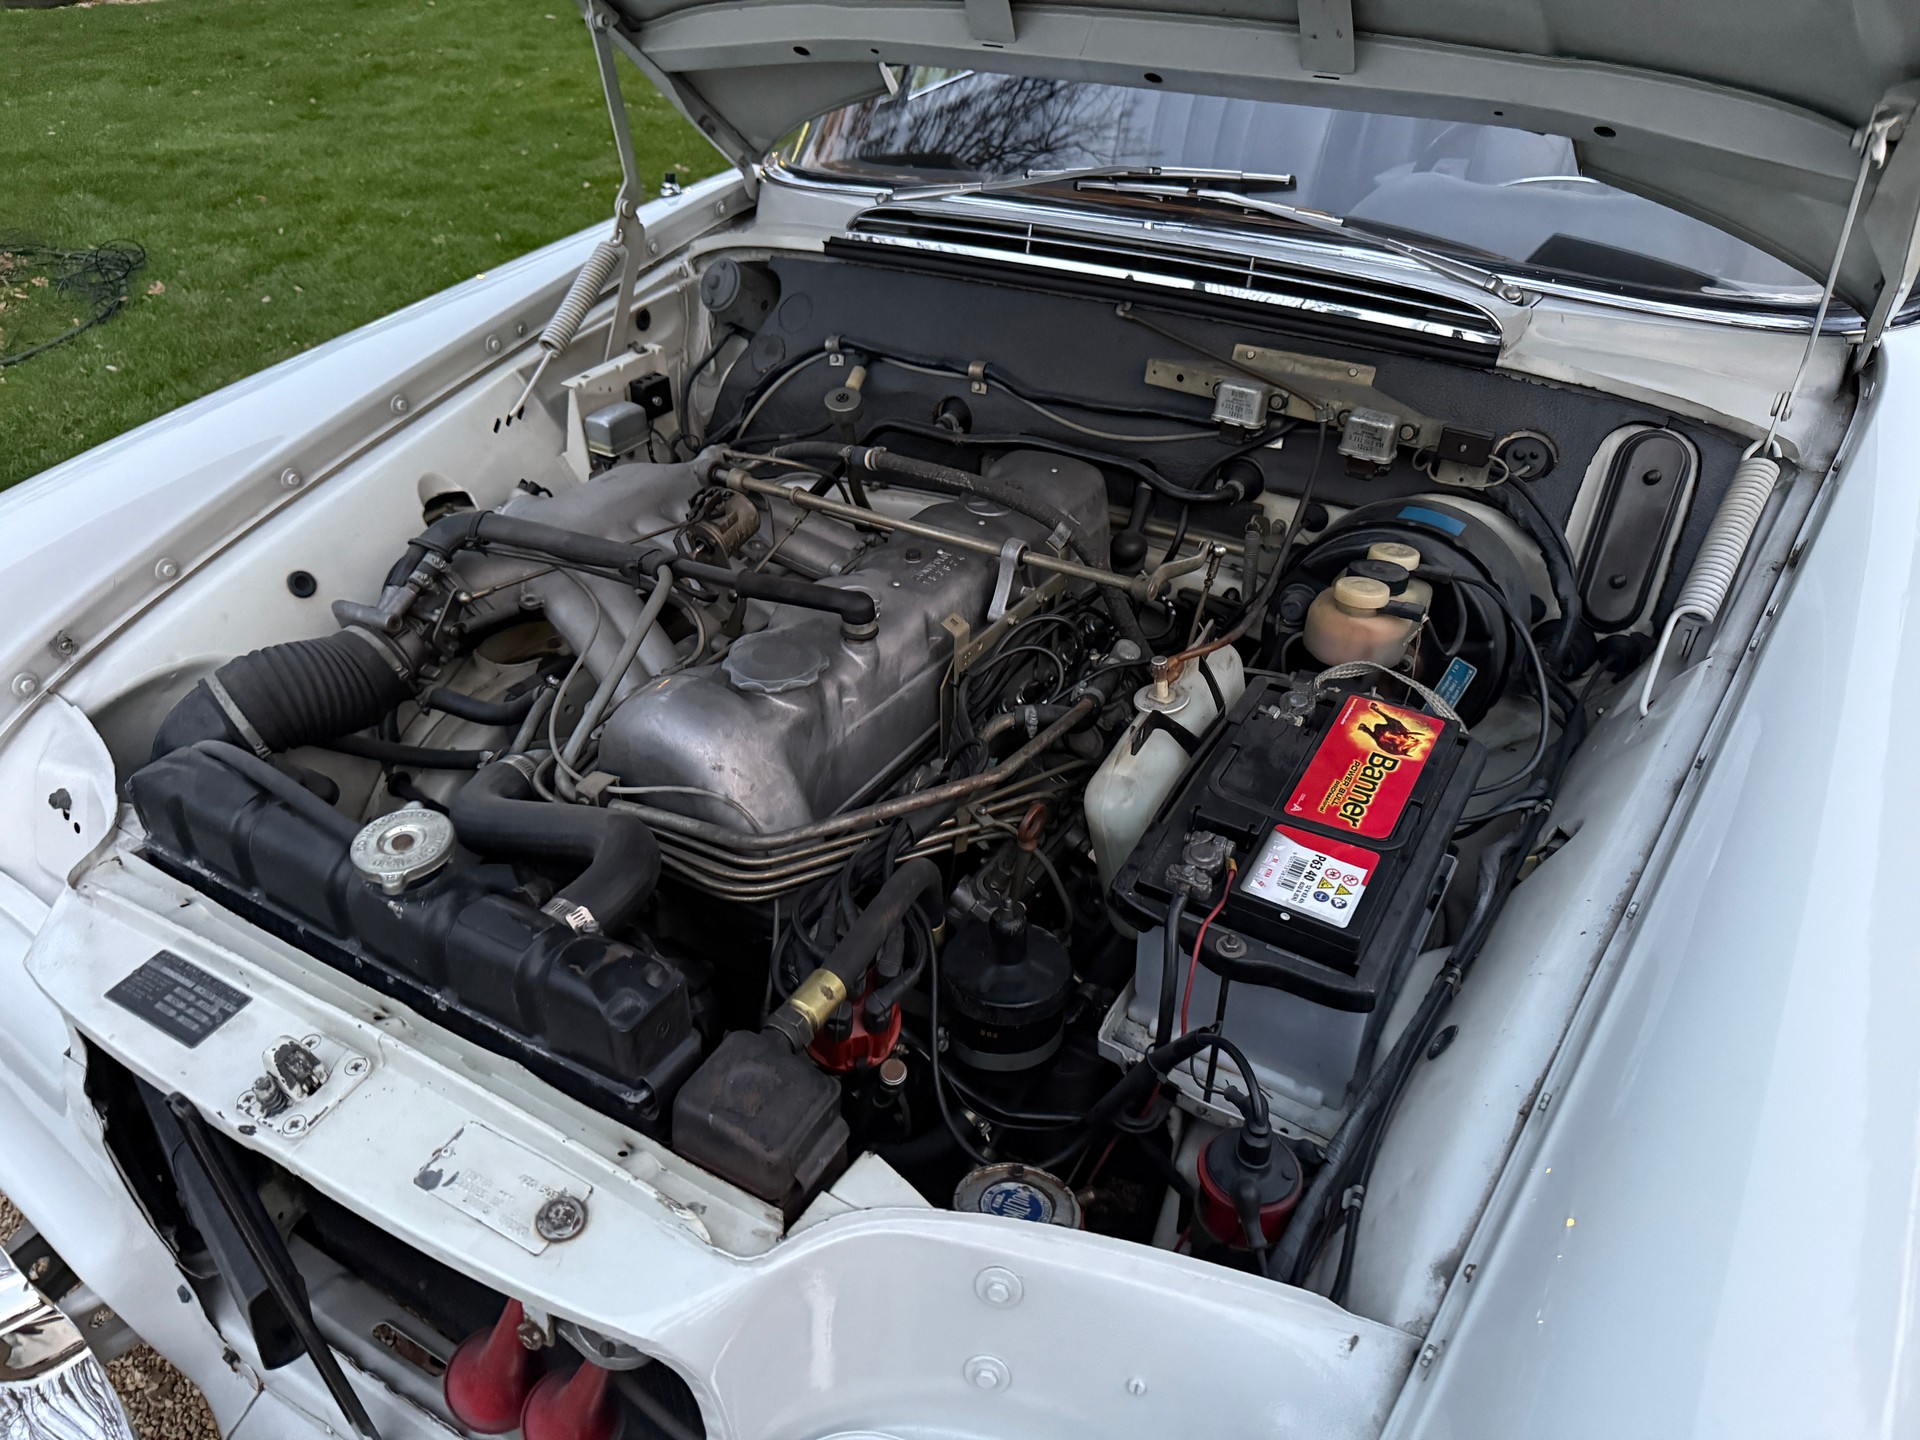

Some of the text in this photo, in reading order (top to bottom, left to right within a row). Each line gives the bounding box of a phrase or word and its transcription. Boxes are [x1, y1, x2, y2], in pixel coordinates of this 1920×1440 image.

[1331, 761, 1361, 805] POWER BULL
[1338, 751, 1400, 828] Banner
[1303, 854, 1327, 882] P63 40
